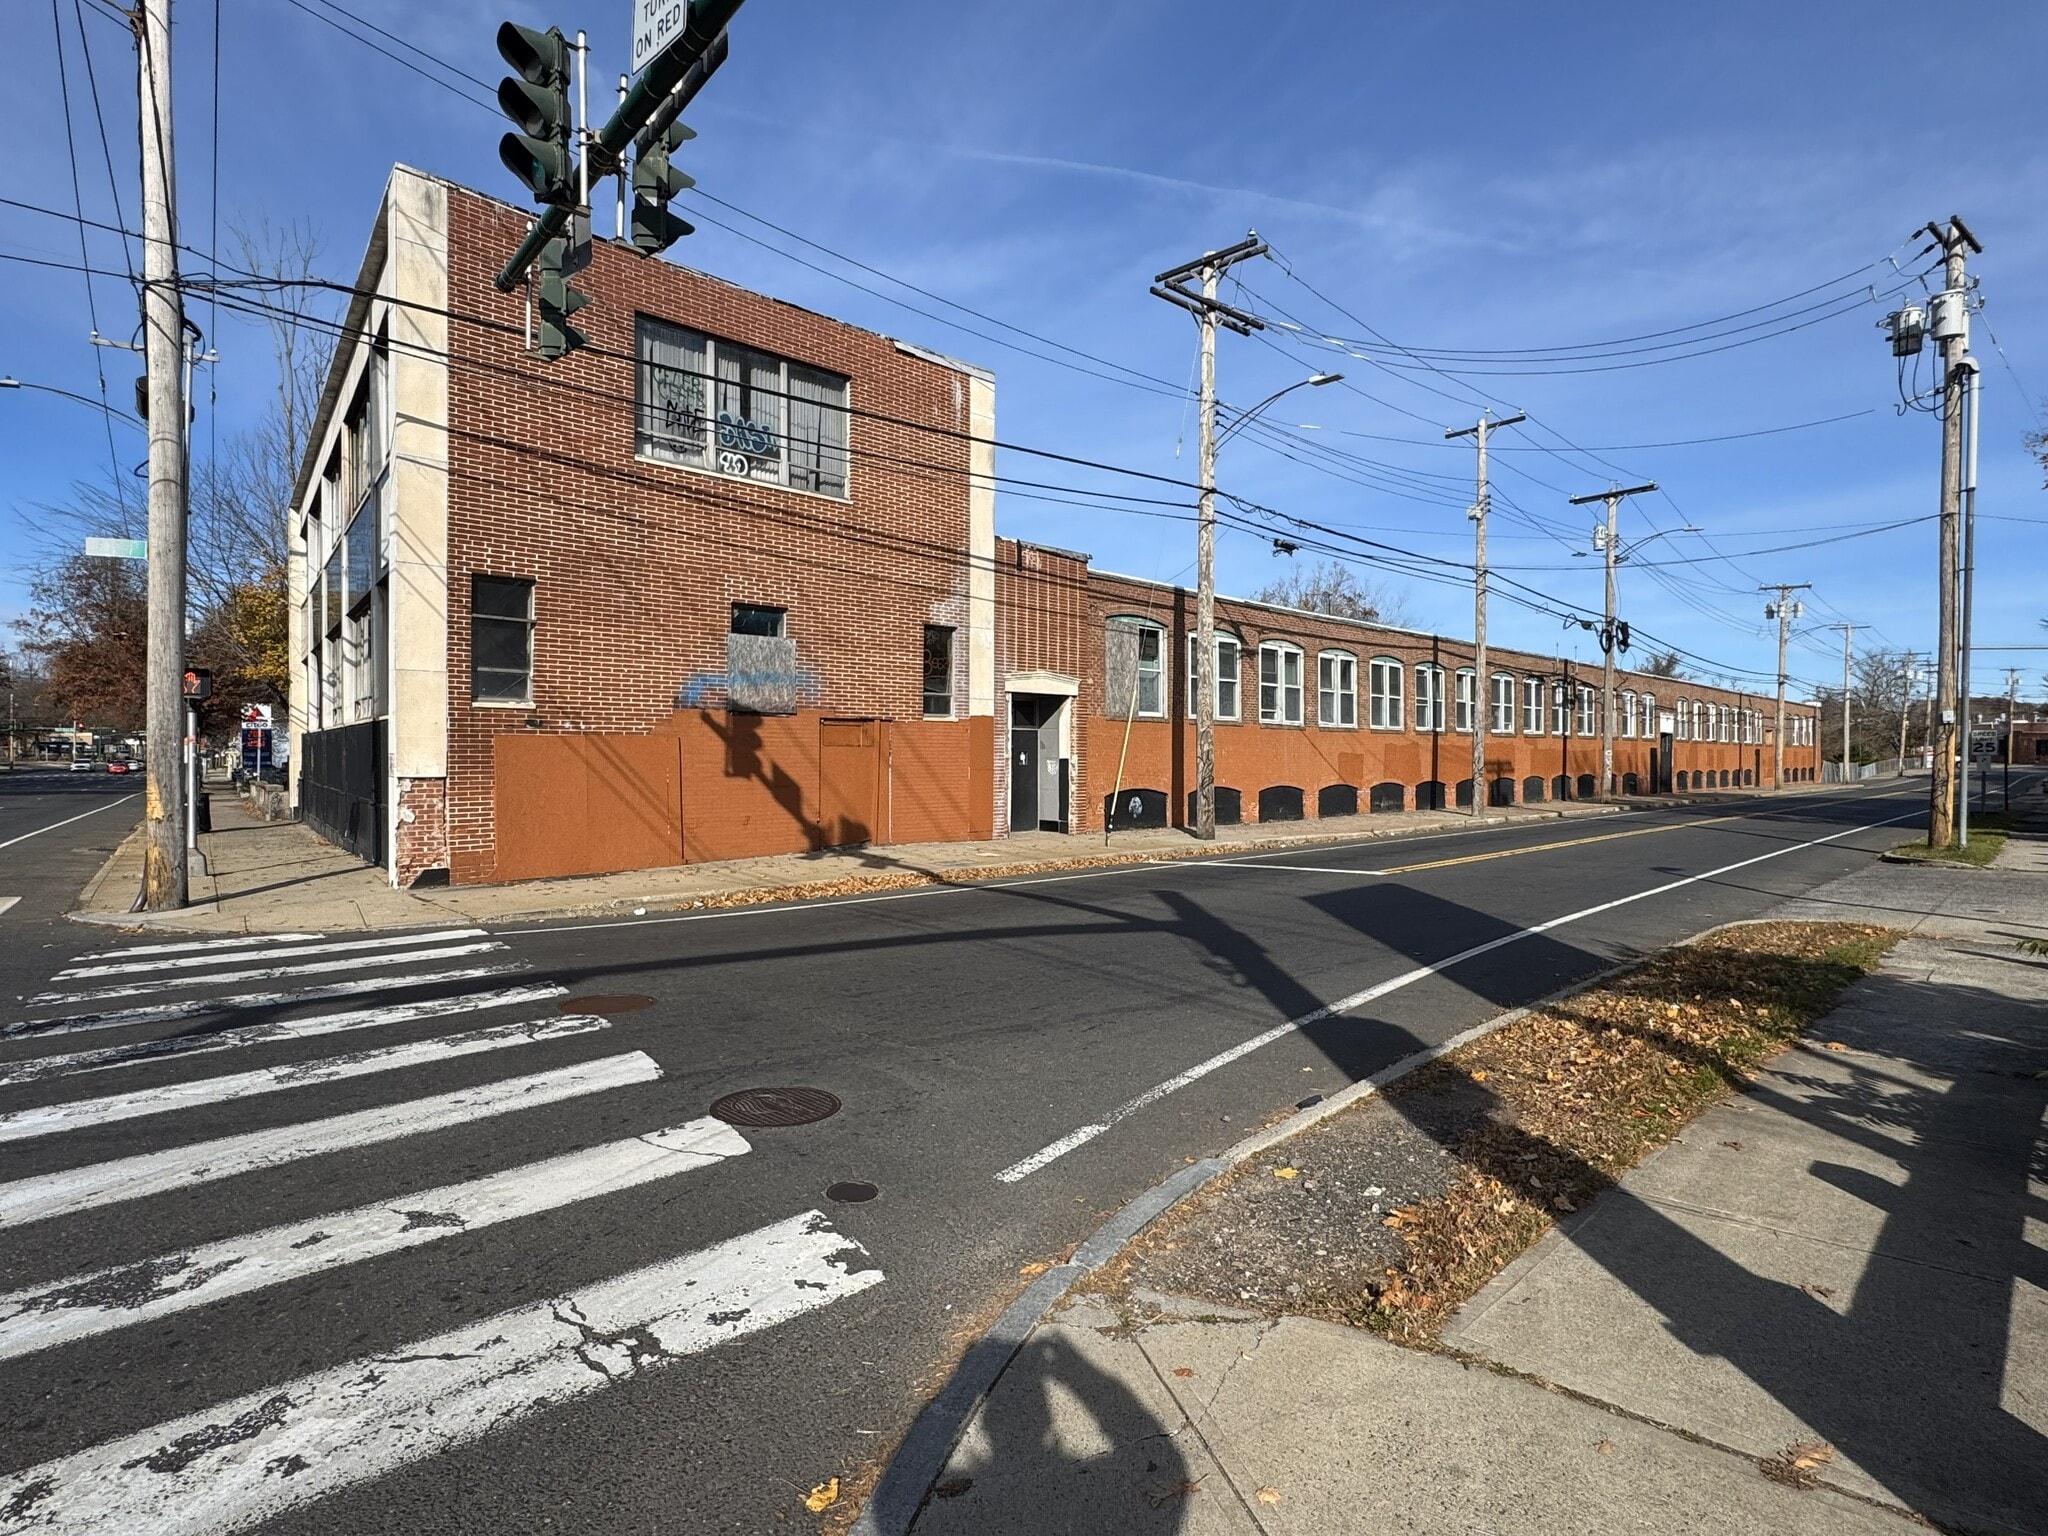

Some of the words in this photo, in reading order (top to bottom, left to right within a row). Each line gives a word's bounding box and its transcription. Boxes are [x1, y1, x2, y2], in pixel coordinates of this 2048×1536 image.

[643, 0, 670, 23] TU
[636, 28, 652, 58] ON
[657, 3, 681, 41] RED
[1973, 742, 1996, 752] 25
